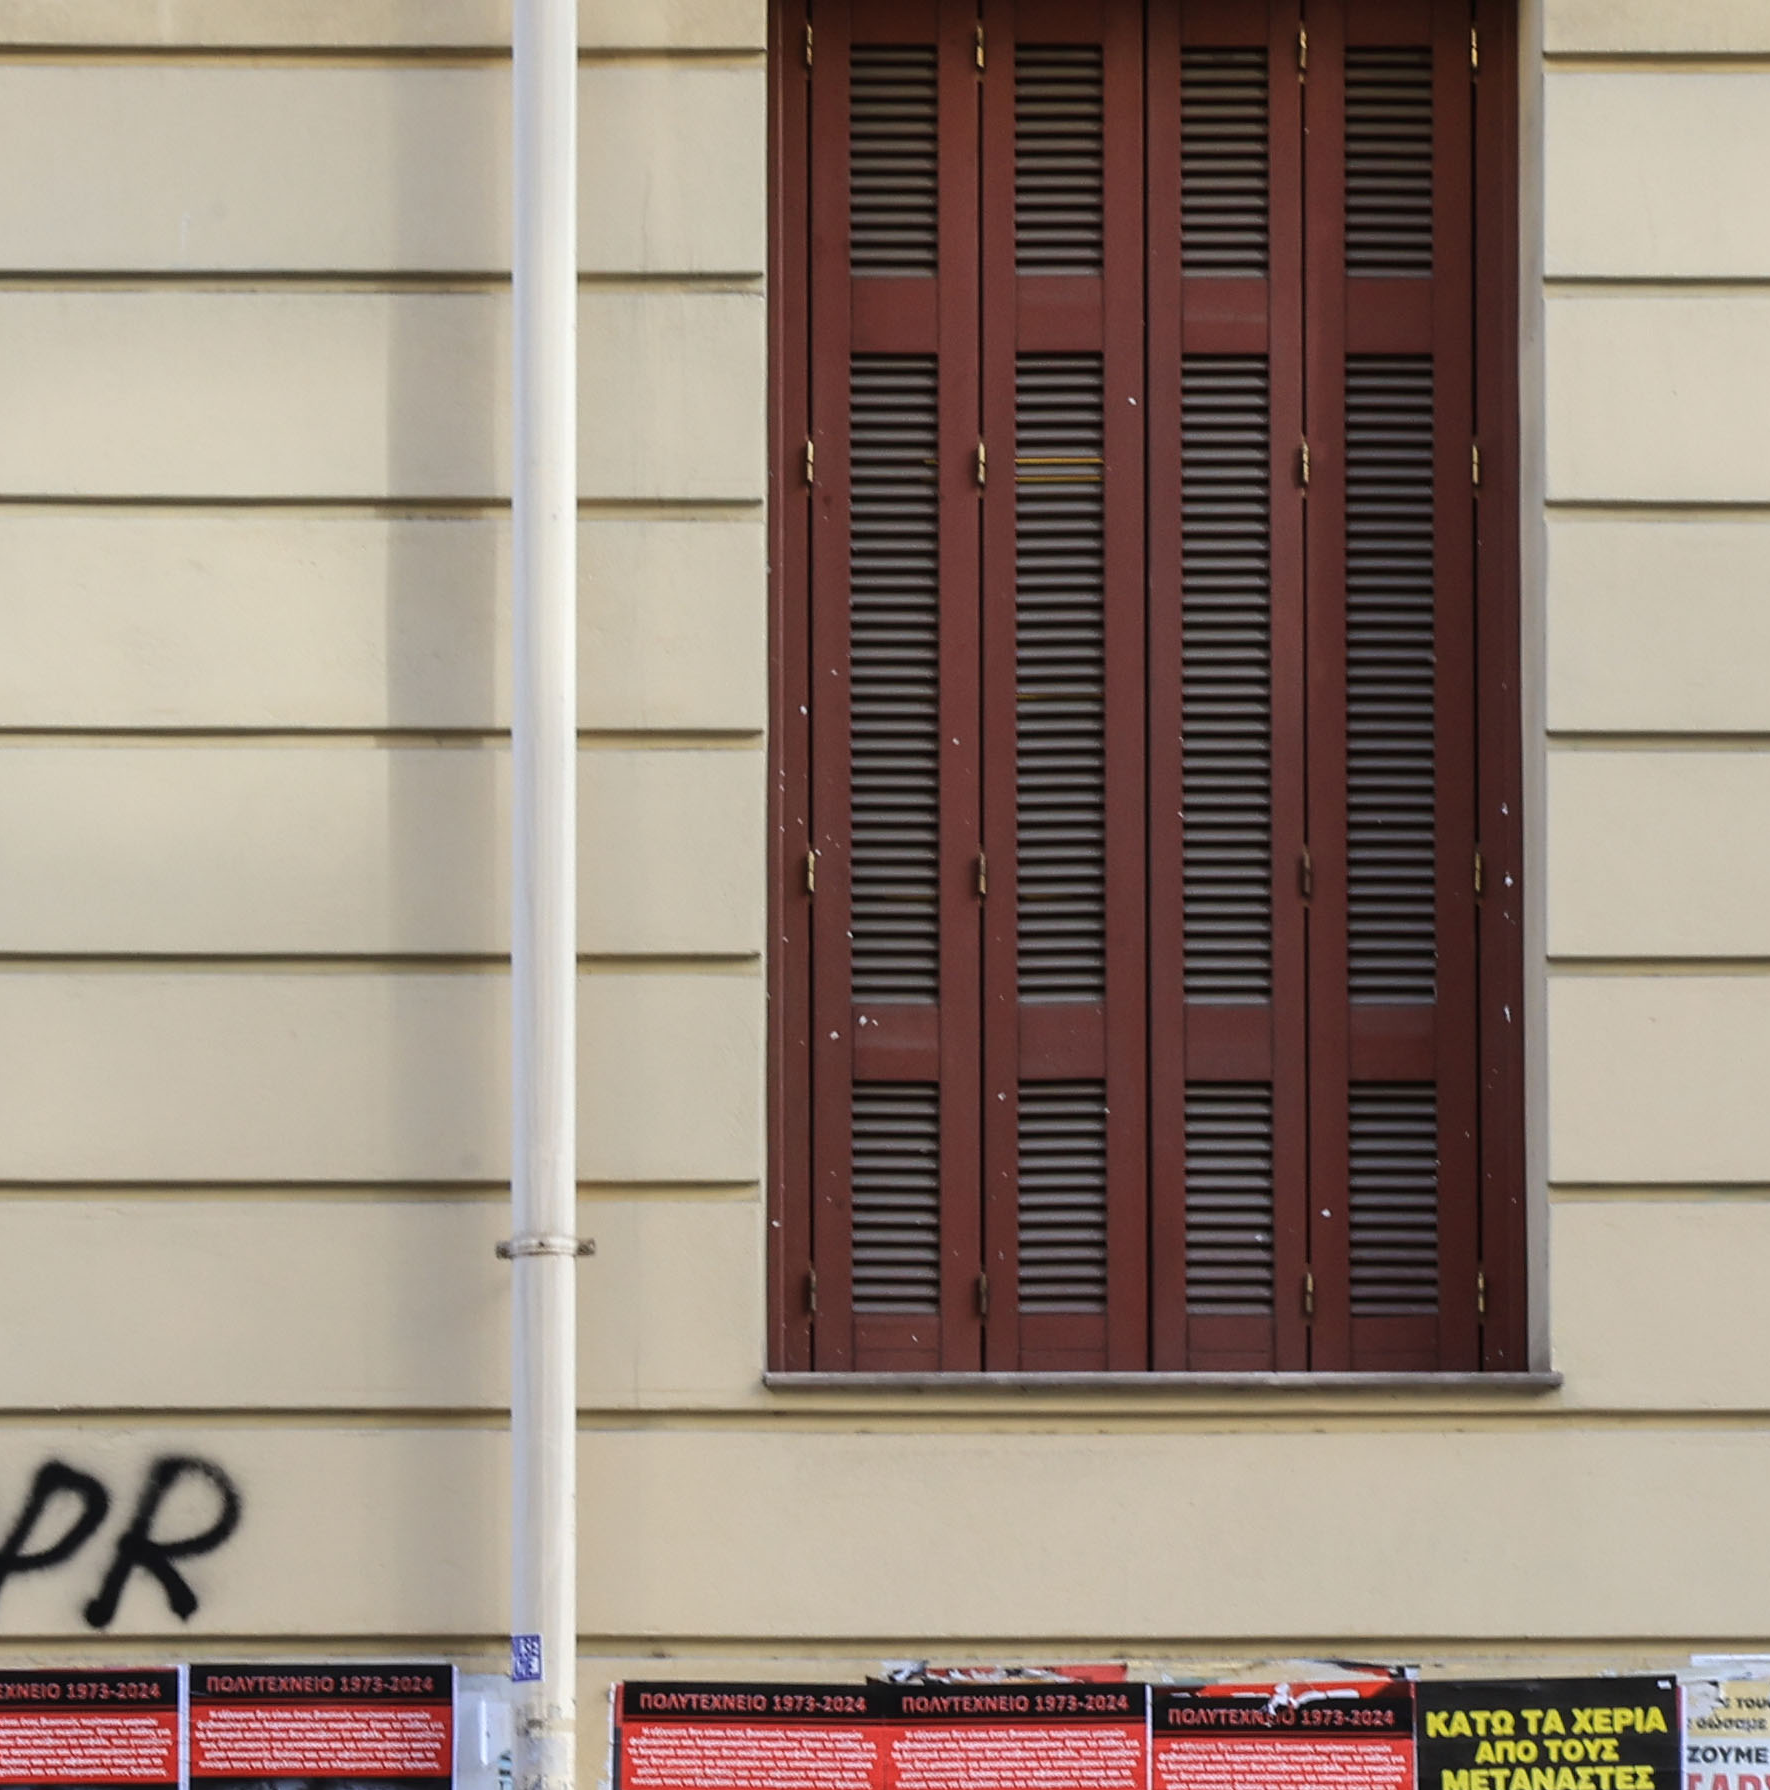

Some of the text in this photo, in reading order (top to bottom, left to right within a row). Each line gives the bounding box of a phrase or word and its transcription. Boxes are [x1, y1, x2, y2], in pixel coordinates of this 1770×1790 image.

[67, 1681, 161, 1700] 1973-2024
[207, 1675, 435, 1694] ΠΟΛΥΤΕΧΝΕΙΟ 1973-2024
[639, 1694, 867, 1712] ΠΟΛΥΤΕΧΝΕΙΟ 1973-2024
[901, 1694, 1129, 1713] ΠΟΛΥΤΕΧΝΕΙΟ 1973-2024
[1301, 1709, 1395, 1727] 1973-2024
[1425, 1707, 1668, 1738] ΚΑΤΩ ΤΑ ΧΕΡΙΑ
[1475, 1738, 1619, 1764] ΑΠΟ ΤΟΥΣ
